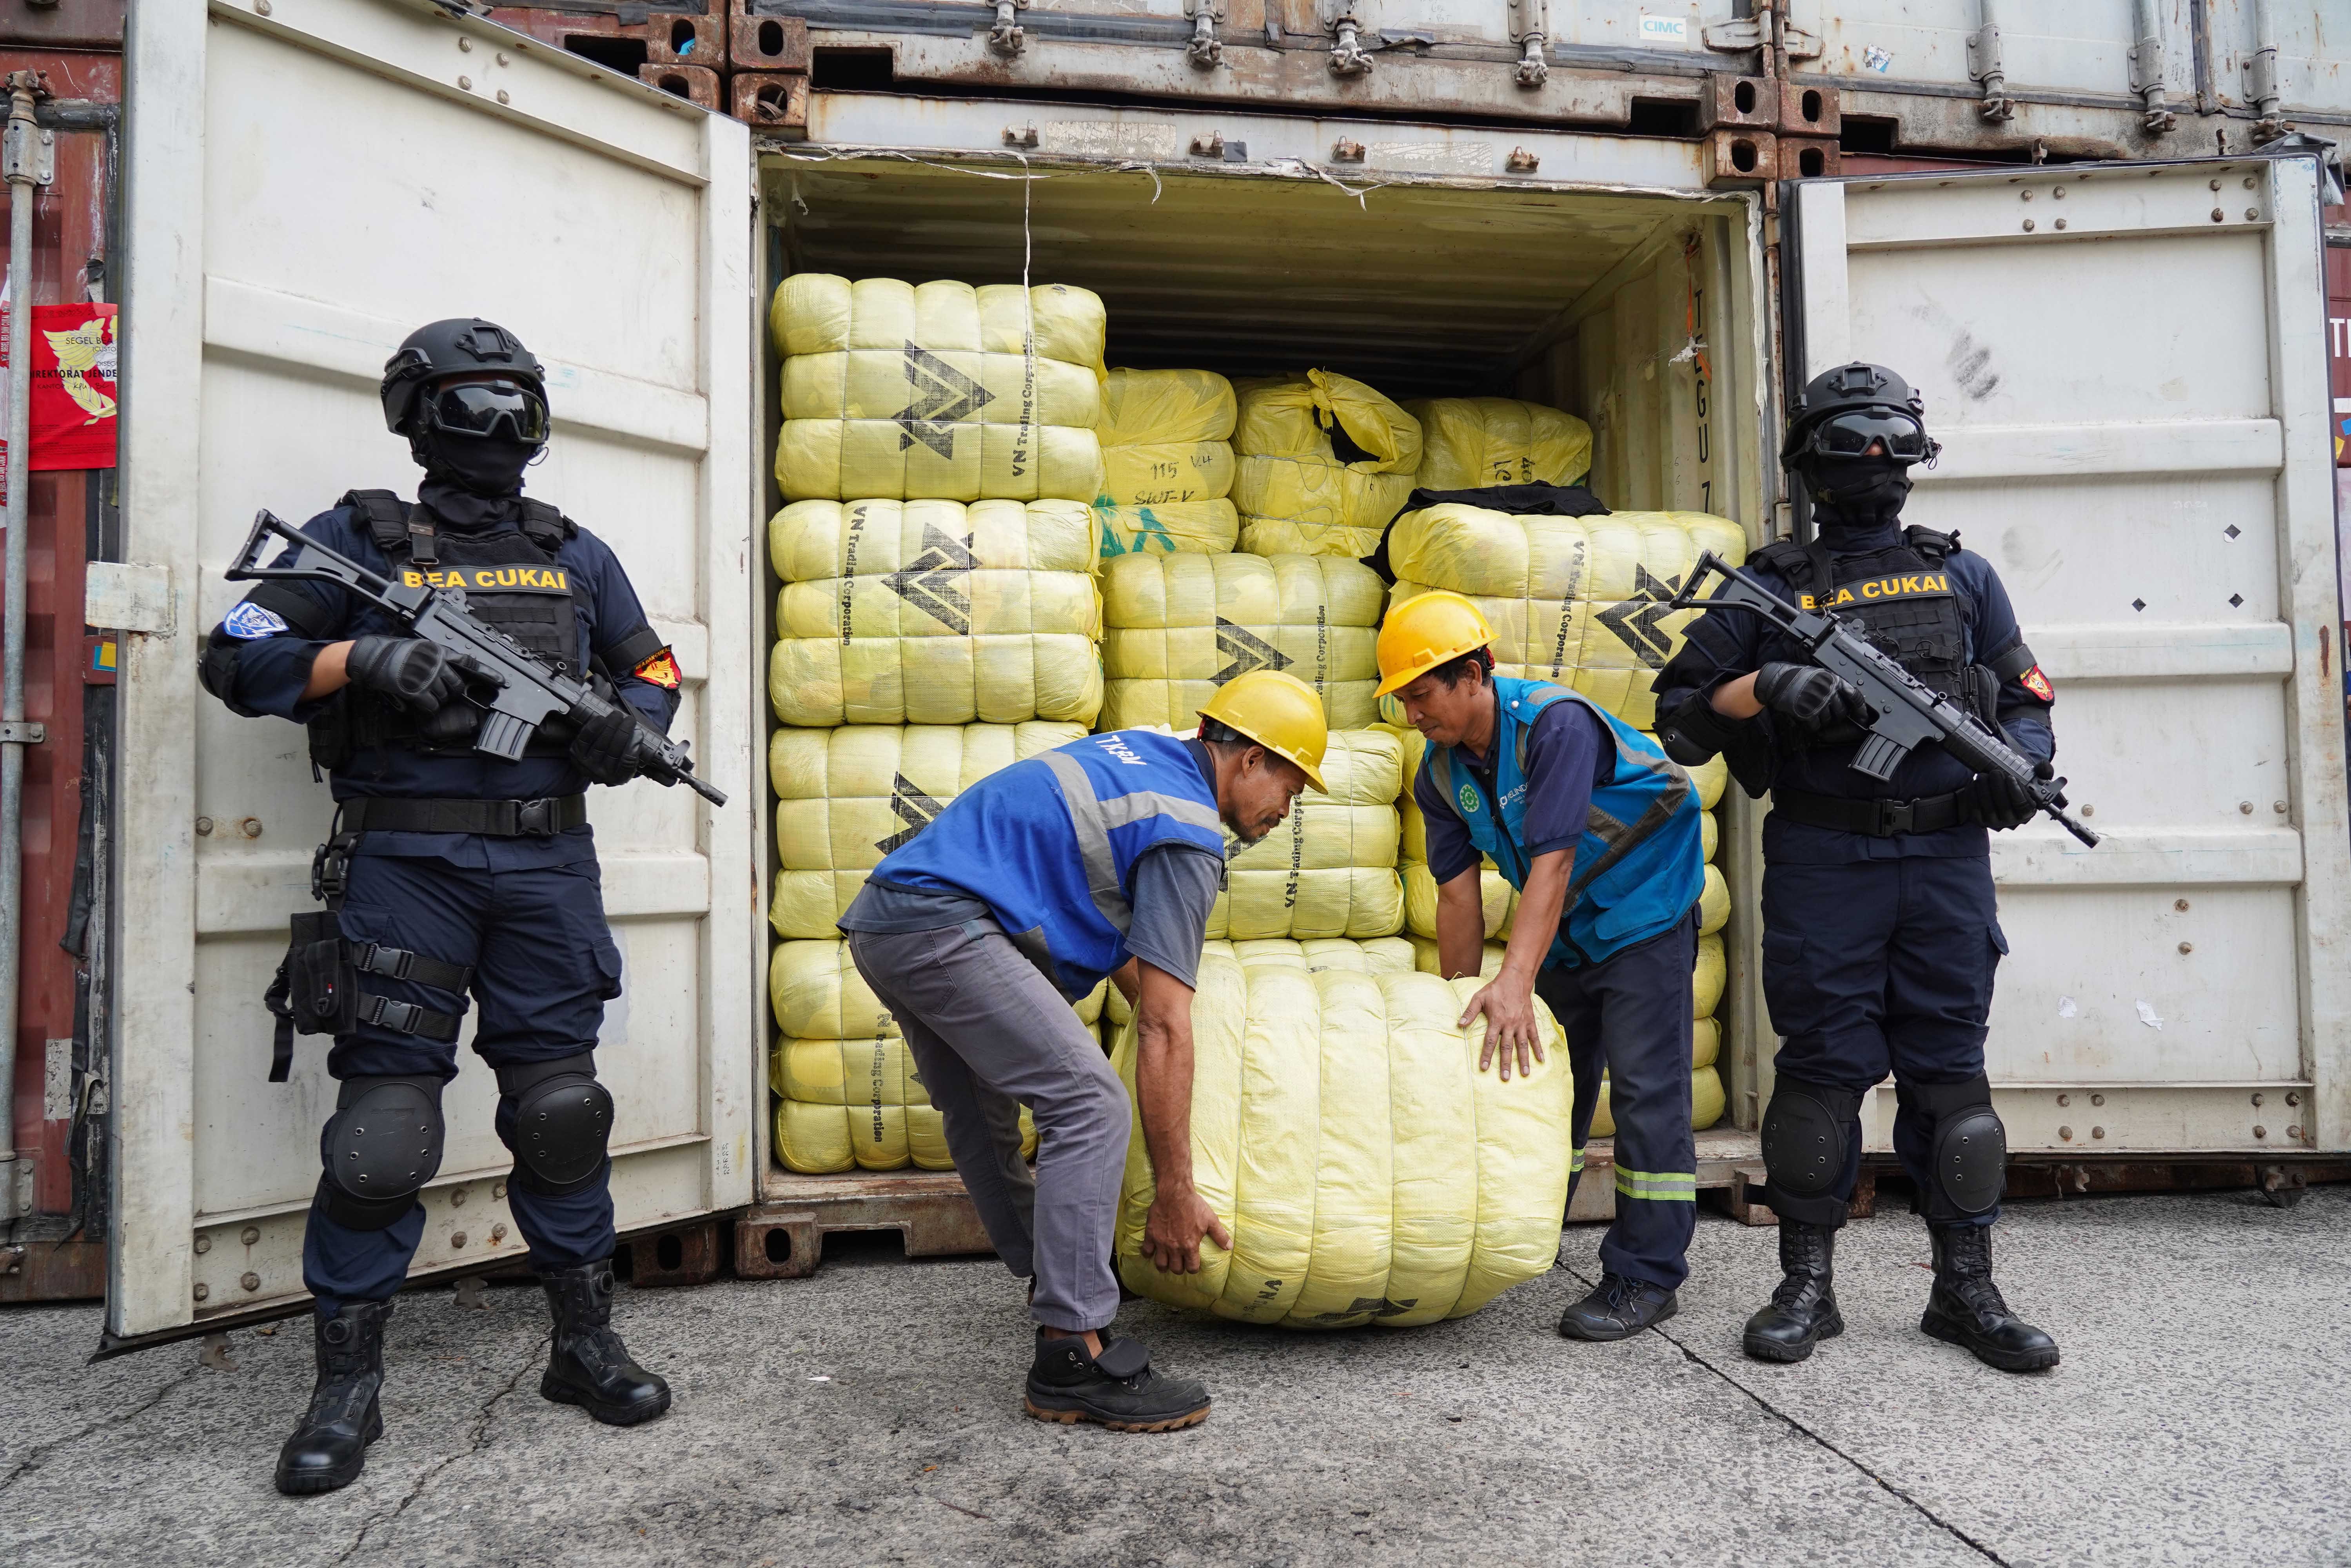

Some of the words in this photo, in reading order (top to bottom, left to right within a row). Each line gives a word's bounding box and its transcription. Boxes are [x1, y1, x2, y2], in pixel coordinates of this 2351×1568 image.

[1643, 20, 1683, 34] CIMC
[88, 370, 117, 378] JENDE
[1017, 400, 1033, 446] Trading
[850, 506, 868, 531] VN
[843, 534, 860, 579] Trading
[403, 570, 468, 588] BEA
[475, 568, 567, 590] CUKAI
[1862, 575, 1948, 598] CUKAI
[841, 580, 854, 646] Corporation
[1316, 605, 1327, 662] Corporation
[1552, 614, 1572, 678] Corporation
[1285, 882, 1298, 908] VN
